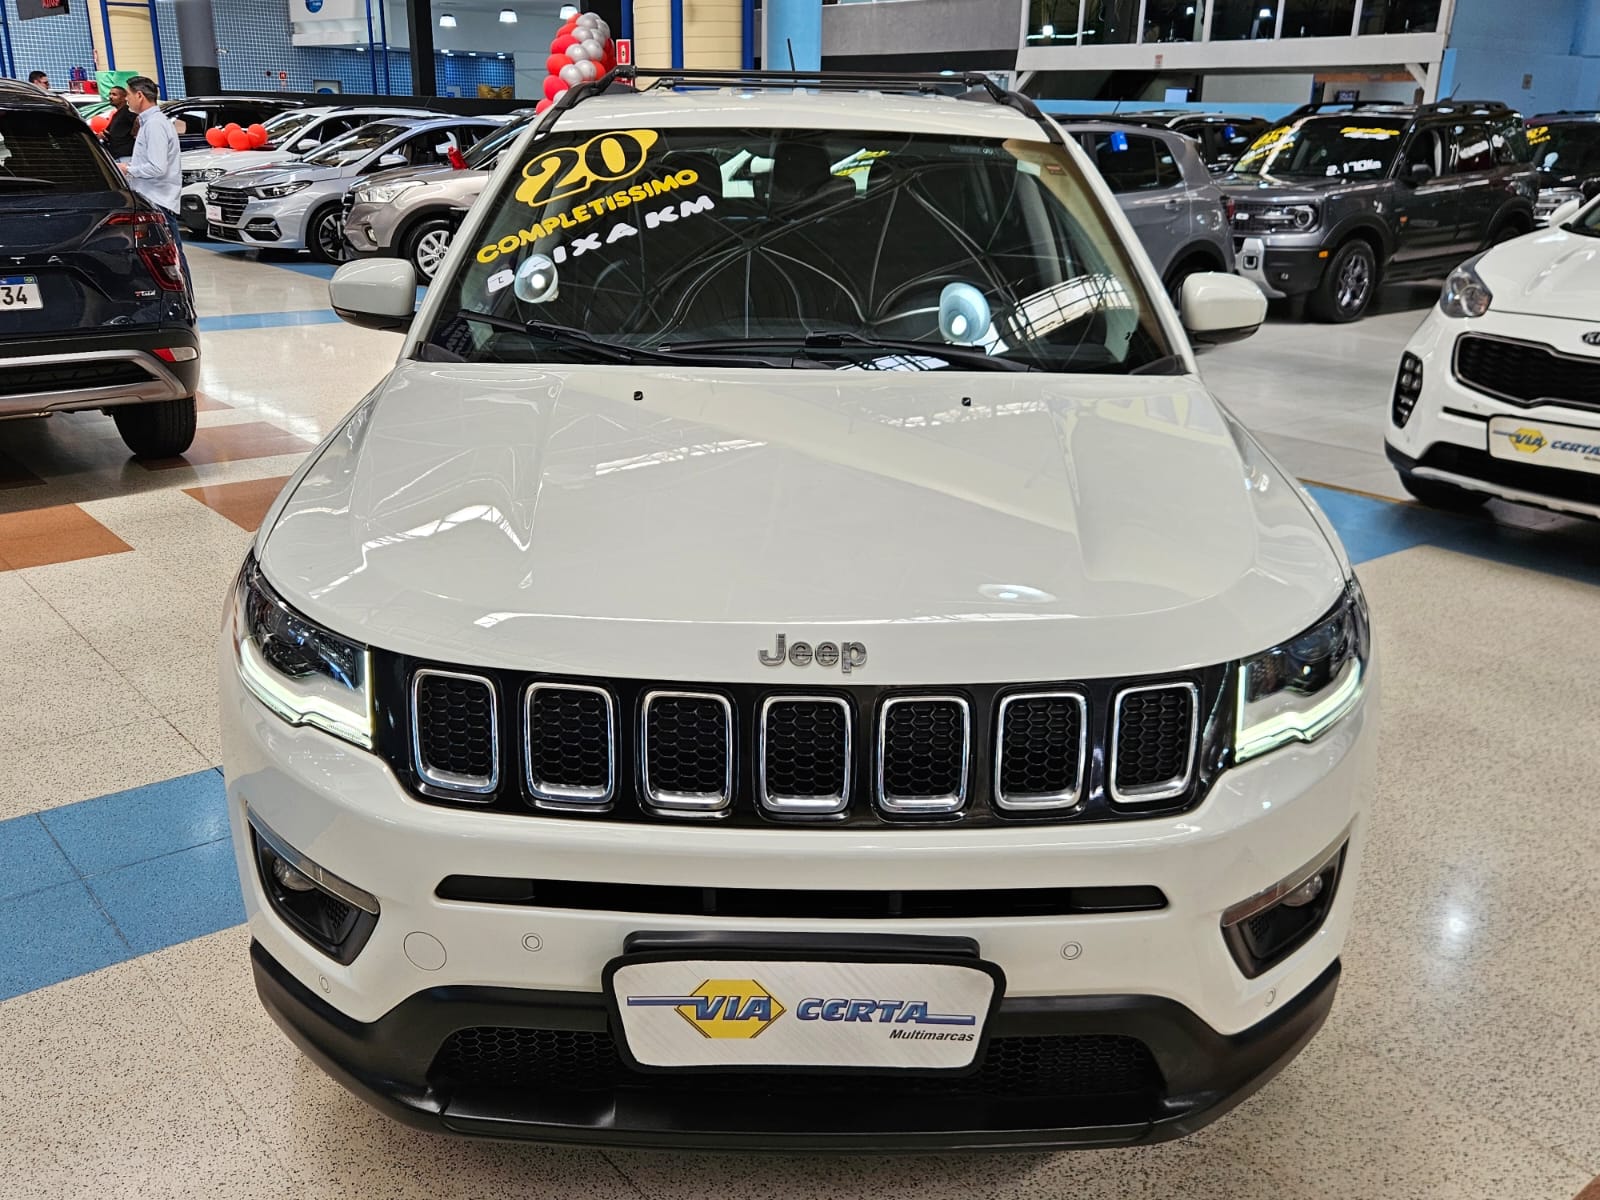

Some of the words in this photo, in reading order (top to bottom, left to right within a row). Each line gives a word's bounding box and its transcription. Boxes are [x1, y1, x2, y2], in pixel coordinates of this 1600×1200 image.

[515, 130, 659, 207] 20
[476, 169, 699, 264] COMPLETISSIMO
[645, 195, 715, 229] KM
[0, 286, 28, 306] 34
[1514, 433, 1544, 448] VIA
[758, 633, 867, 674] Jeep
[695, 995, 772, 1022] VIA
[796, 997, 930, 1024] CERTA
[889, 1029, 975, 1043] Multimarcas
